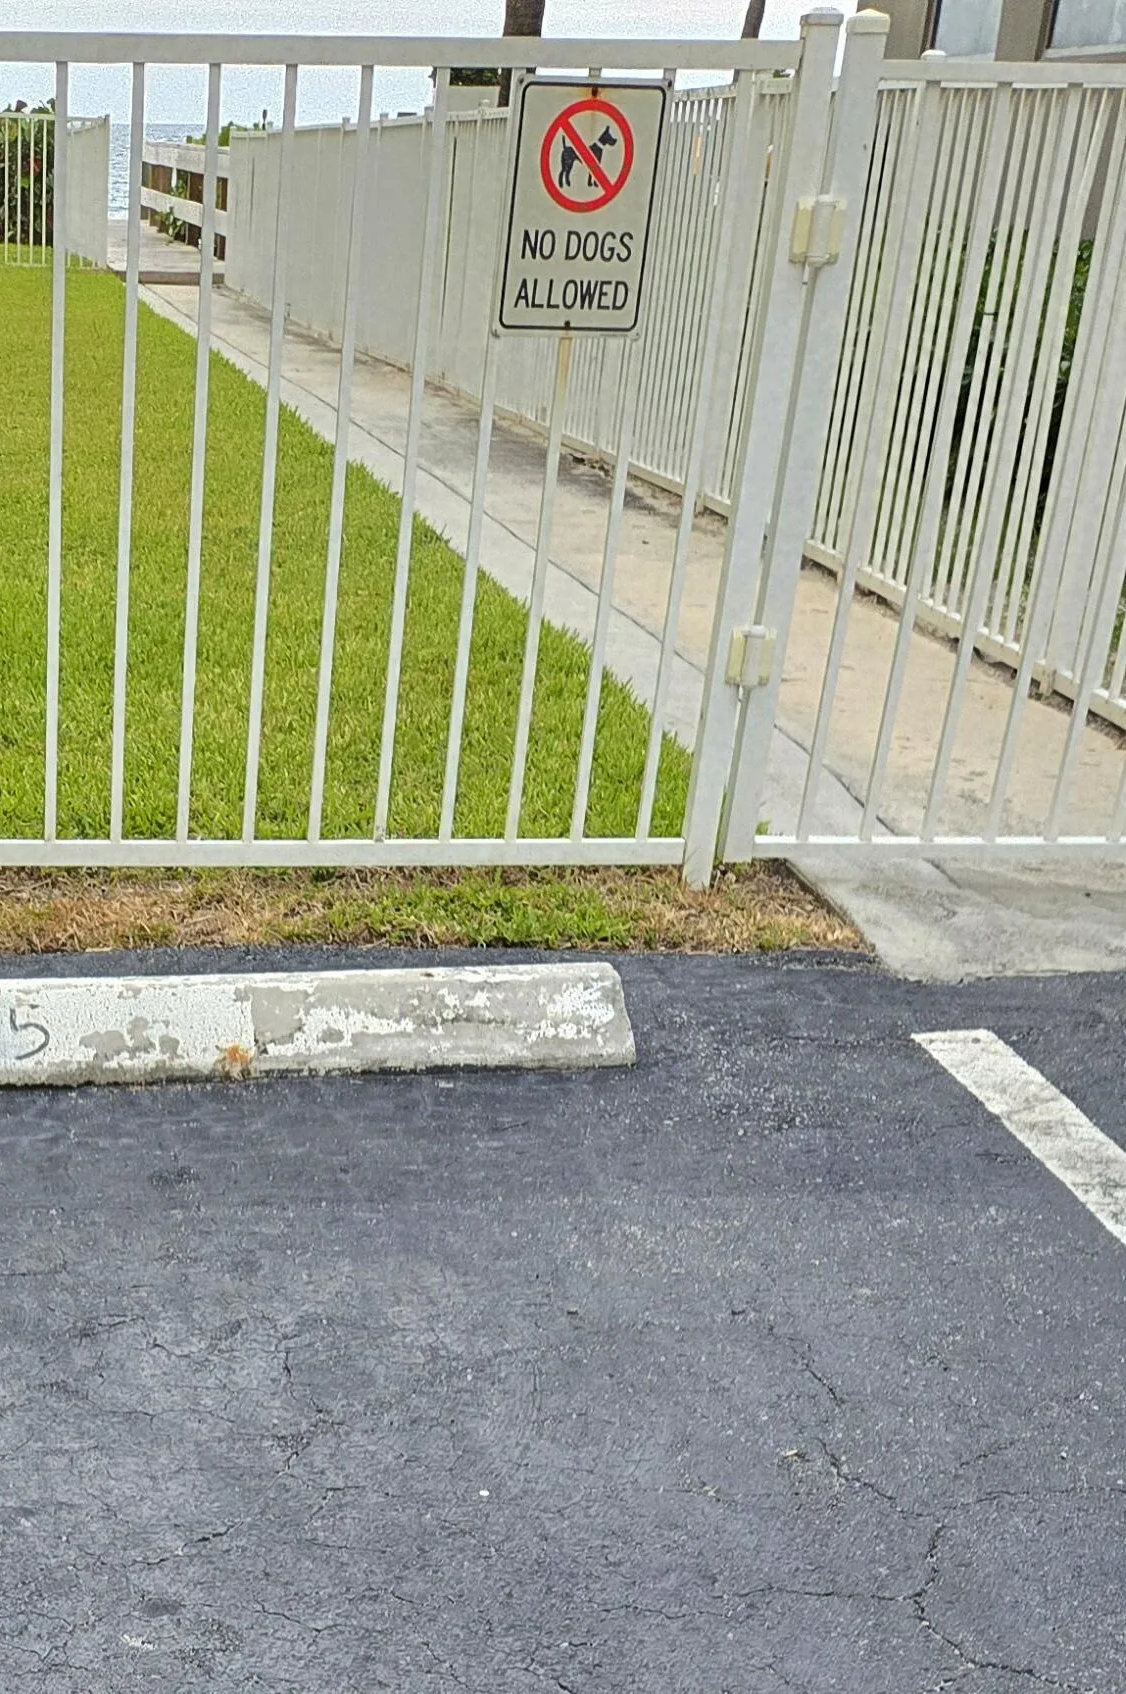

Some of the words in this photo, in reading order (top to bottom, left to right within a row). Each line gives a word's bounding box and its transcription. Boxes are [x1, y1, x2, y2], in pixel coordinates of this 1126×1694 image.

[521, 229, 556, 260] NO
[564, 230, 634, 263] DOGS
[514, 278, 630, 311] ALLOWED
